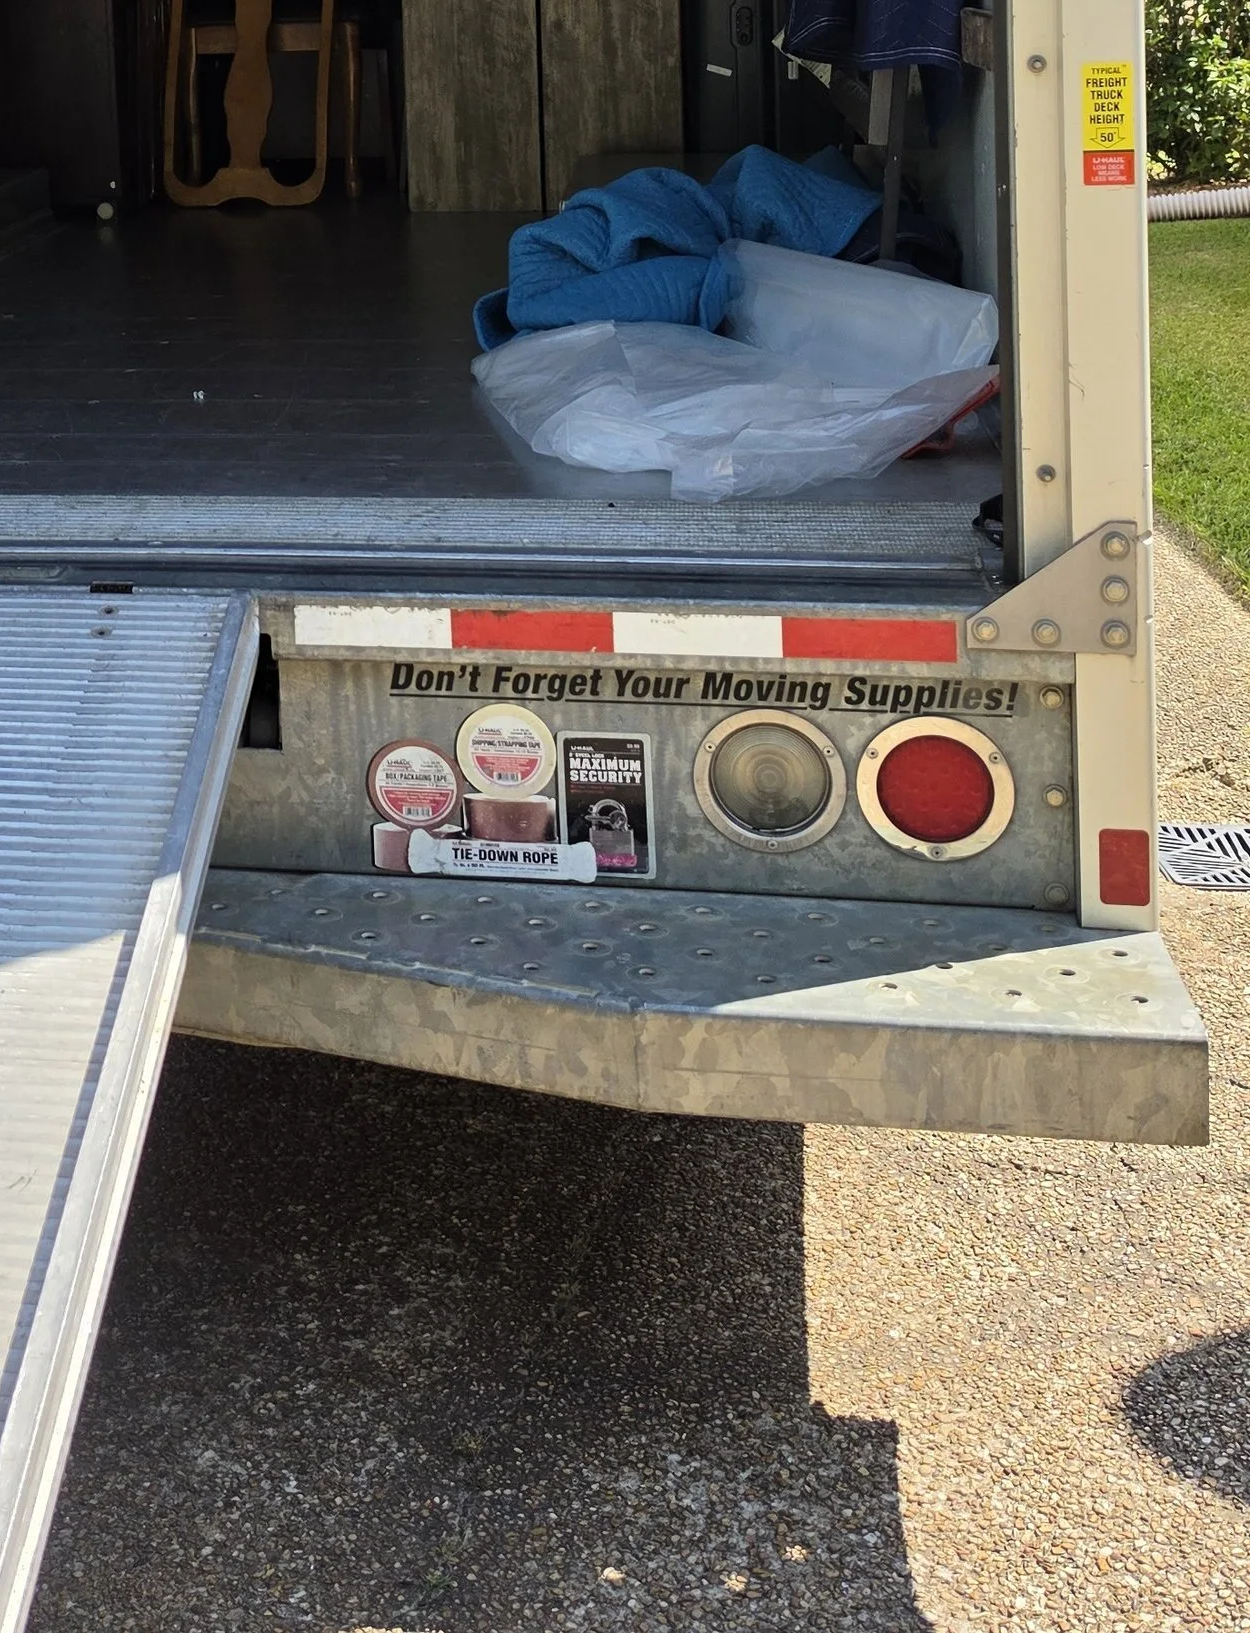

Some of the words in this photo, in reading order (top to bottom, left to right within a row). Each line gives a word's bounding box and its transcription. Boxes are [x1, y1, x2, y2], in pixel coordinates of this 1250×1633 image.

[1091, 66, 1122, 74] TYPICAL
[1086, 77, 1128, 88] FREIGHT
[1090, 90, 1123, 100] TRUCK
[1094, 102, 1120, 112] DECK
[1089, 114, 1125, 125] HEIGHT
[389, 662, 481, 692] Don't
[491, 666, 602, 703] Forget
[615, 669, 690, 699] Your
[700, 671, 832, 711] Moving
[844, 676, 1019, 714] Supplies!
[569, 757, 641, 771] MAXIMUM
[433, 774, 447, 783] TAPE
[569, 770, 642, 783] SECURITY
[451, 847, 519, 862] TIE-DOWN
[523, 851, 559, 865] ROPE
